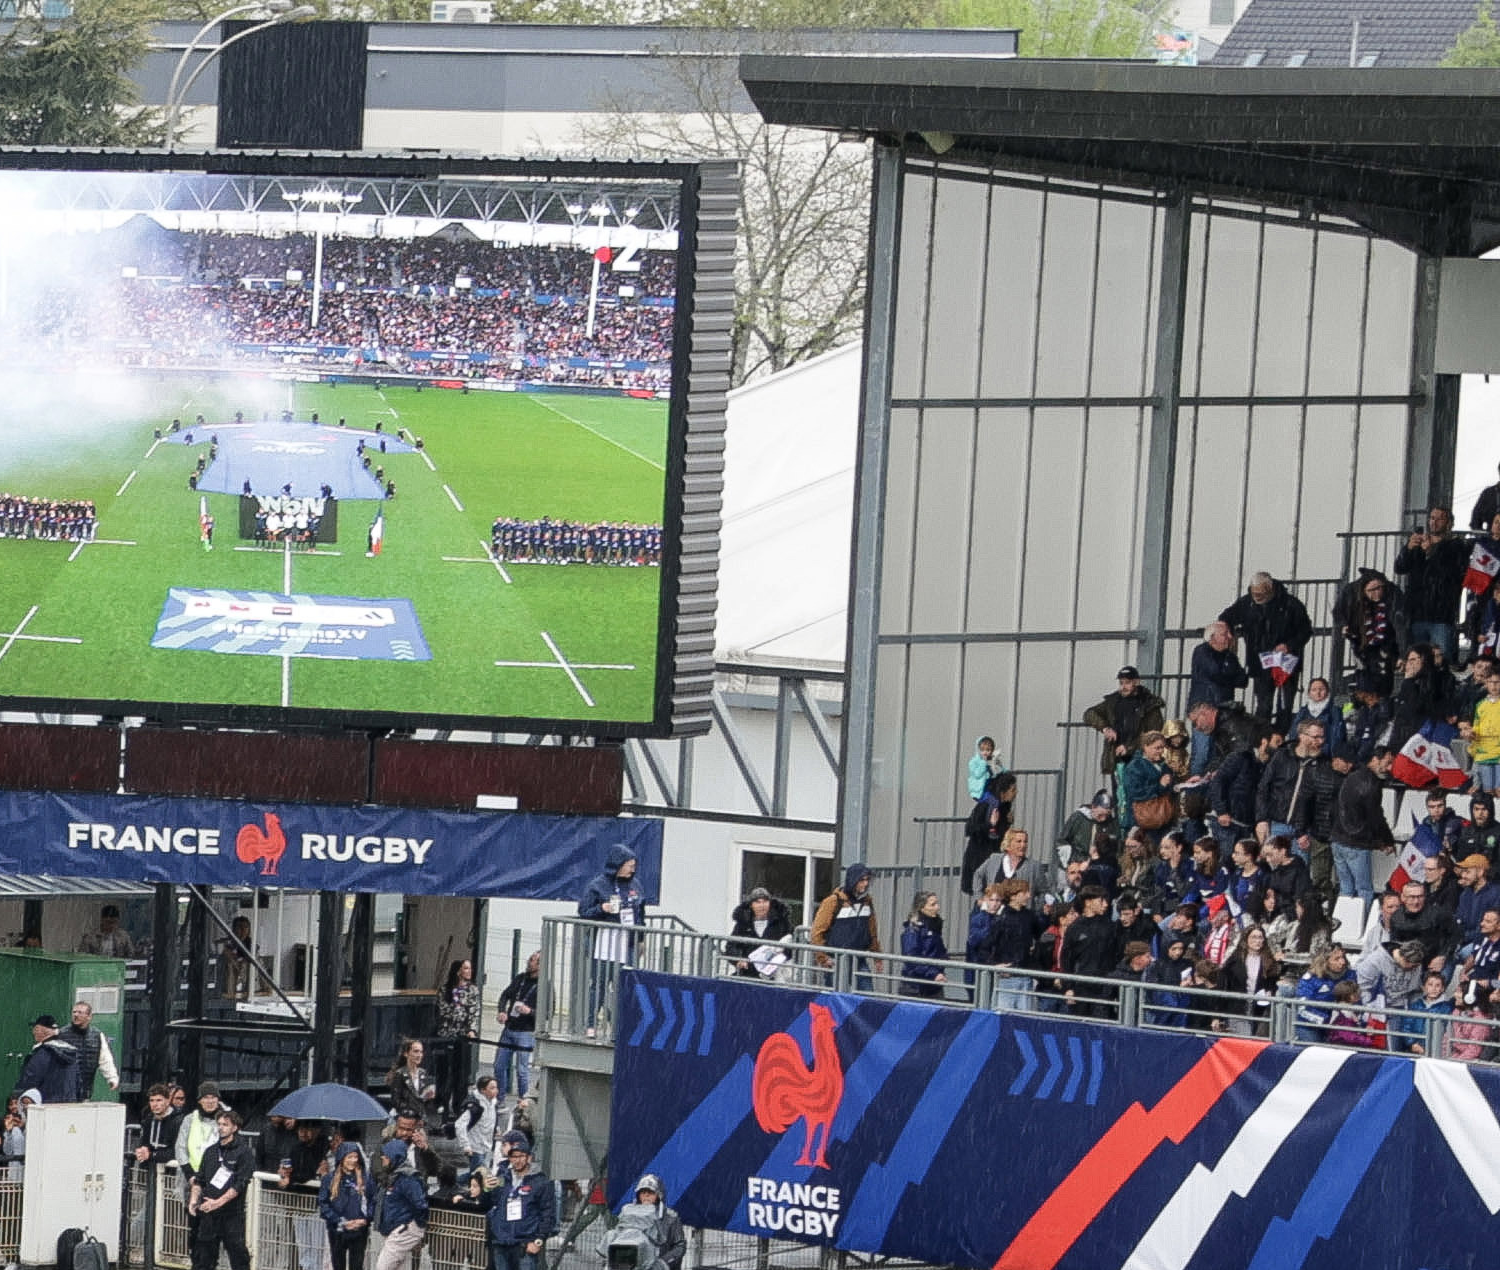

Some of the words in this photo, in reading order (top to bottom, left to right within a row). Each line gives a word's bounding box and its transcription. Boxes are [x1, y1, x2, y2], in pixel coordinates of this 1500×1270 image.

[68, 822, 220, 854] FRANCE
[302, 833, 433, 865] RUGBY
[748, 1177, 840, 1211] FRANCE
[749, 1202, 840, 1238] RUGBY
